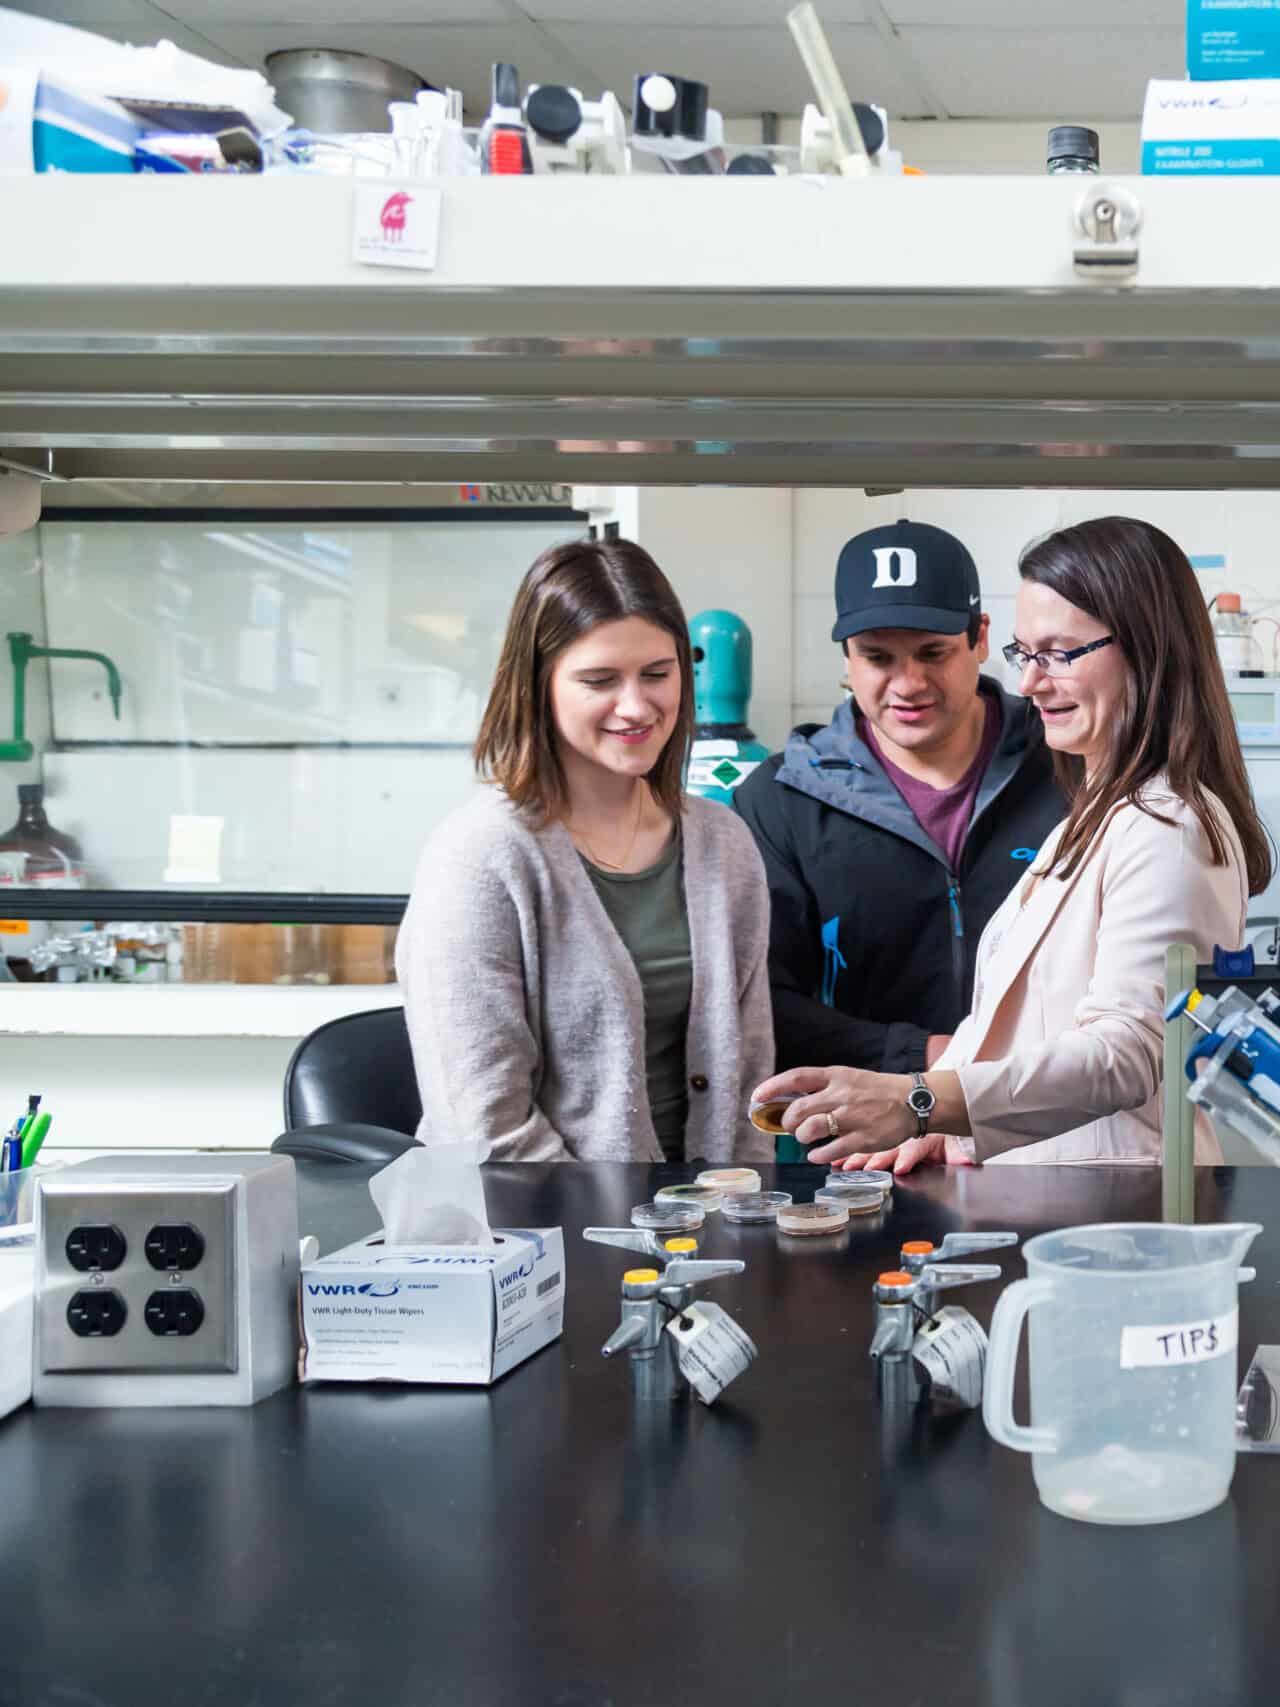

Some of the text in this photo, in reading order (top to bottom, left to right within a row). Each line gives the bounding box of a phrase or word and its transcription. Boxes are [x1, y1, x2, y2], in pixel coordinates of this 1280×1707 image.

[871, 546, 918, 589] D
[499, 1272, 519, 1289] VWR
[308, 1284, 356, 1296] VWR
[312, 1306, 425, 1317] VWR Light-Duty Tissue Wipers
